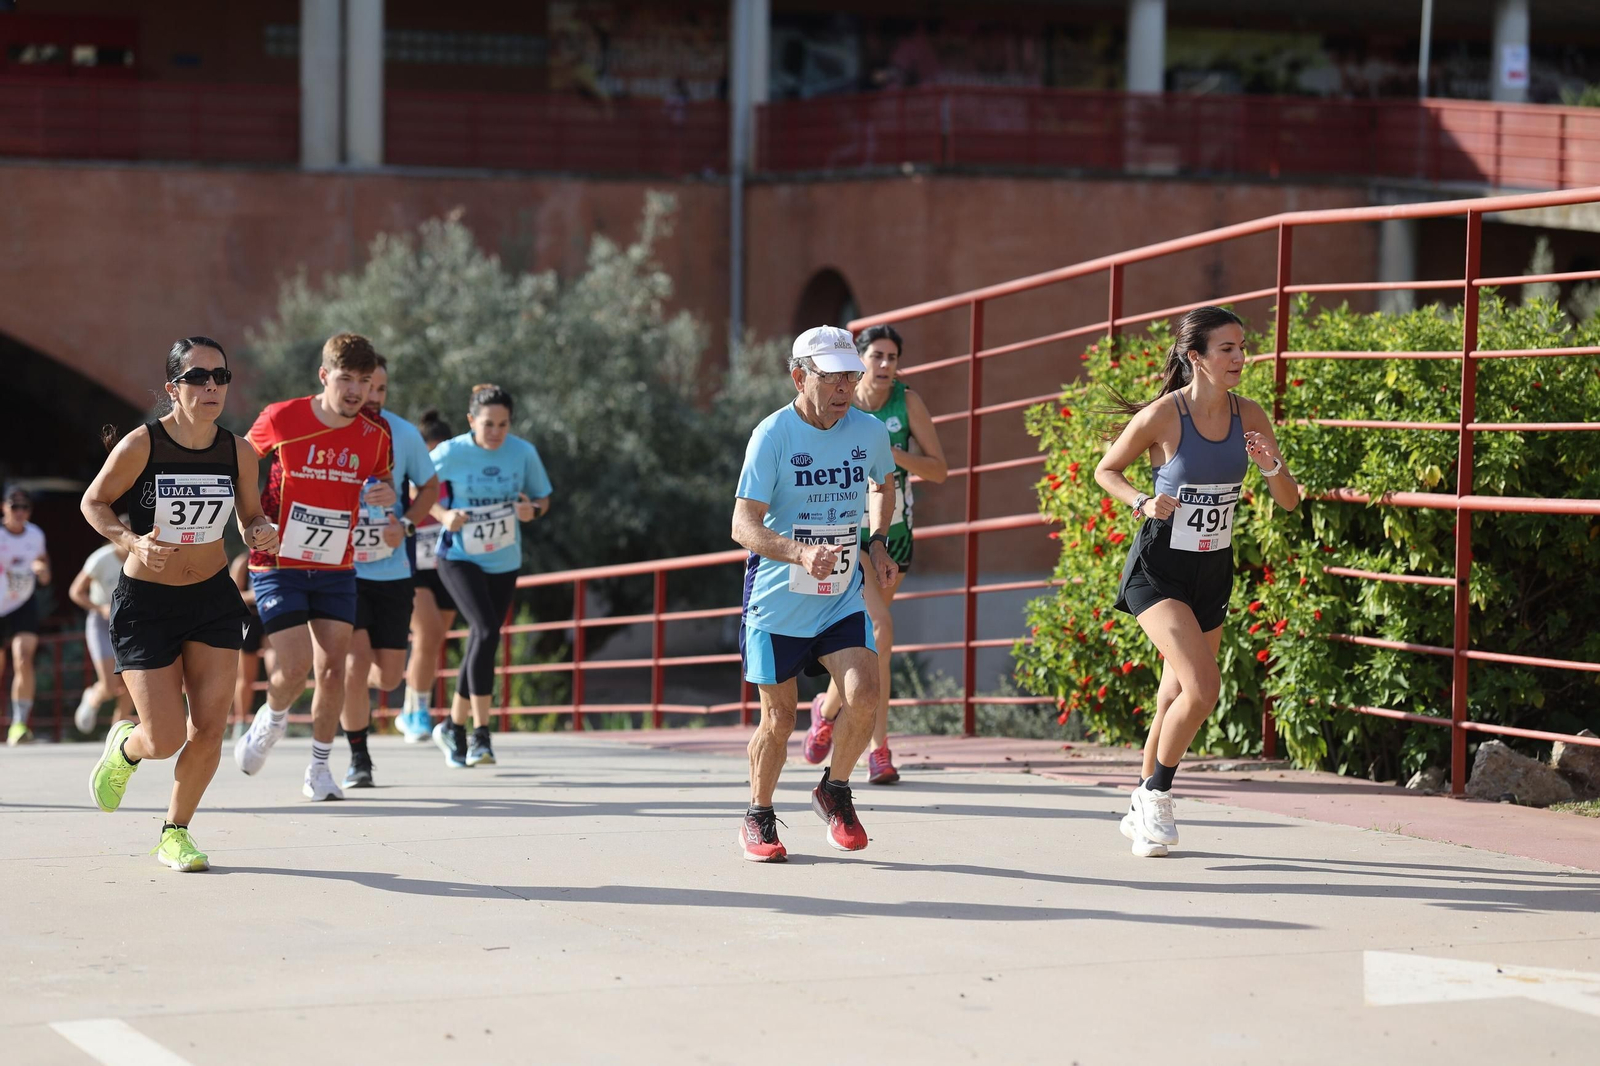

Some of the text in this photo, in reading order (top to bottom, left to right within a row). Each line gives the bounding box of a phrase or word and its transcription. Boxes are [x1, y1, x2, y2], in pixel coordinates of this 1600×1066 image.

[791, 455, 813, 466] TROPS
[794, 460, 865, 490] nerja
[160, 486, 195, 496] UMA
[806, 491, 858, 504] ATLETISMO
[1181, 493, 1215, 505] UMA
[169, 500, 224, 526] 377
[292, 511, 321, 525] UMA
[1187, 507, 1229, 532] 491
[304, 526, 333, 548] 77
[354, 528, 380, 547] 25
[473, 520, 508, 540] 471
